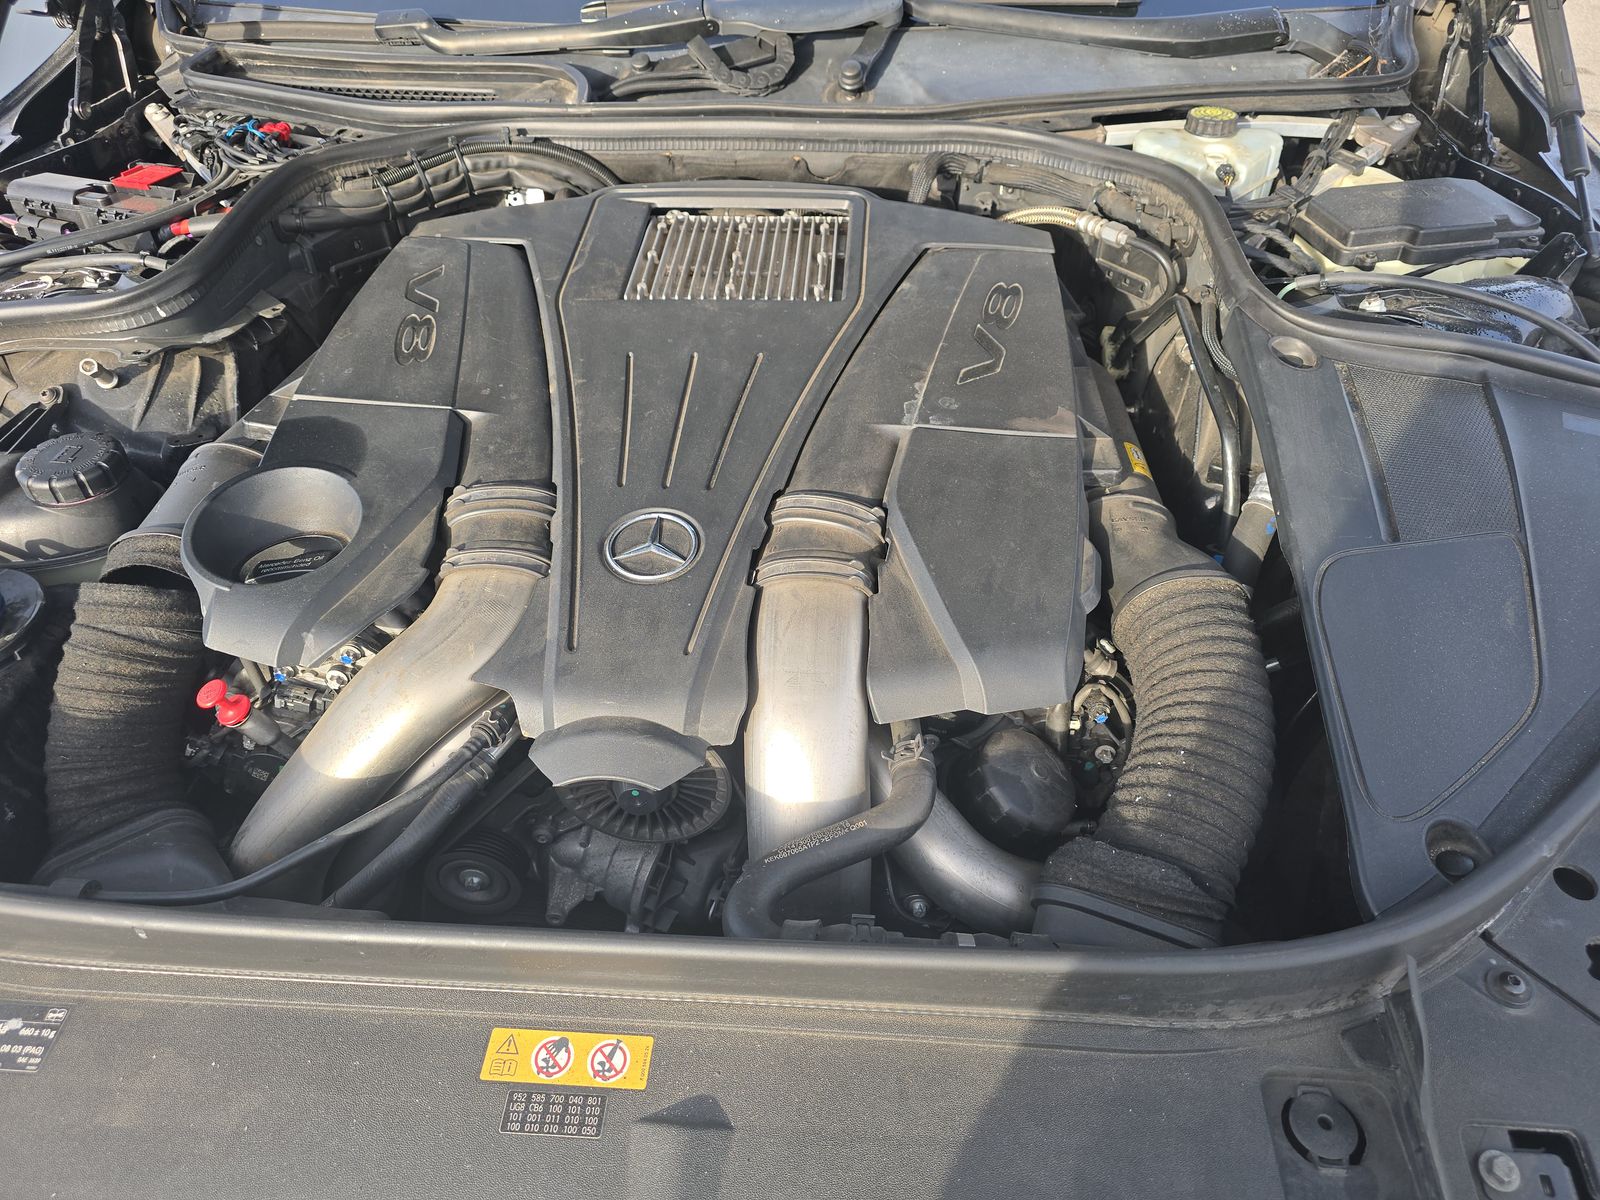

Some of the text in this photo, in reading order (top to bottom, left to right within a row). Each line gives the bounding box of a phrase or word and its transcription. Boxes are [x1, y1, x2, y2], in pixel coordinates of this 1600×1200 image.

[394, 264, 446, 366] V8
[956, 282, 1024, 385] V8
[18, 1027, 35, 1036] 660
[22, 1045, 44, 1056] (PAG)
[513, 1093, 527, 1101] 952
[550, 1095, 564, 1103] 700
[569, 1096, 583, 1104] 040
[549, 1105, 562, 1113] 100
[568, 1106, 580, 1114] 101
[586, 1107, 600, 1115] 010
[546, 1114, 560, 1123] 011
[565, 1116, 579, 1124] 010
[585, 1116, 598, 1125] 100
[507, 1123, 520, 1131] 100
[525, 1124, 539, 1132] 010
[544, 1124, 558, 1133] 010
[581, 1126, 596, 1135] 050
